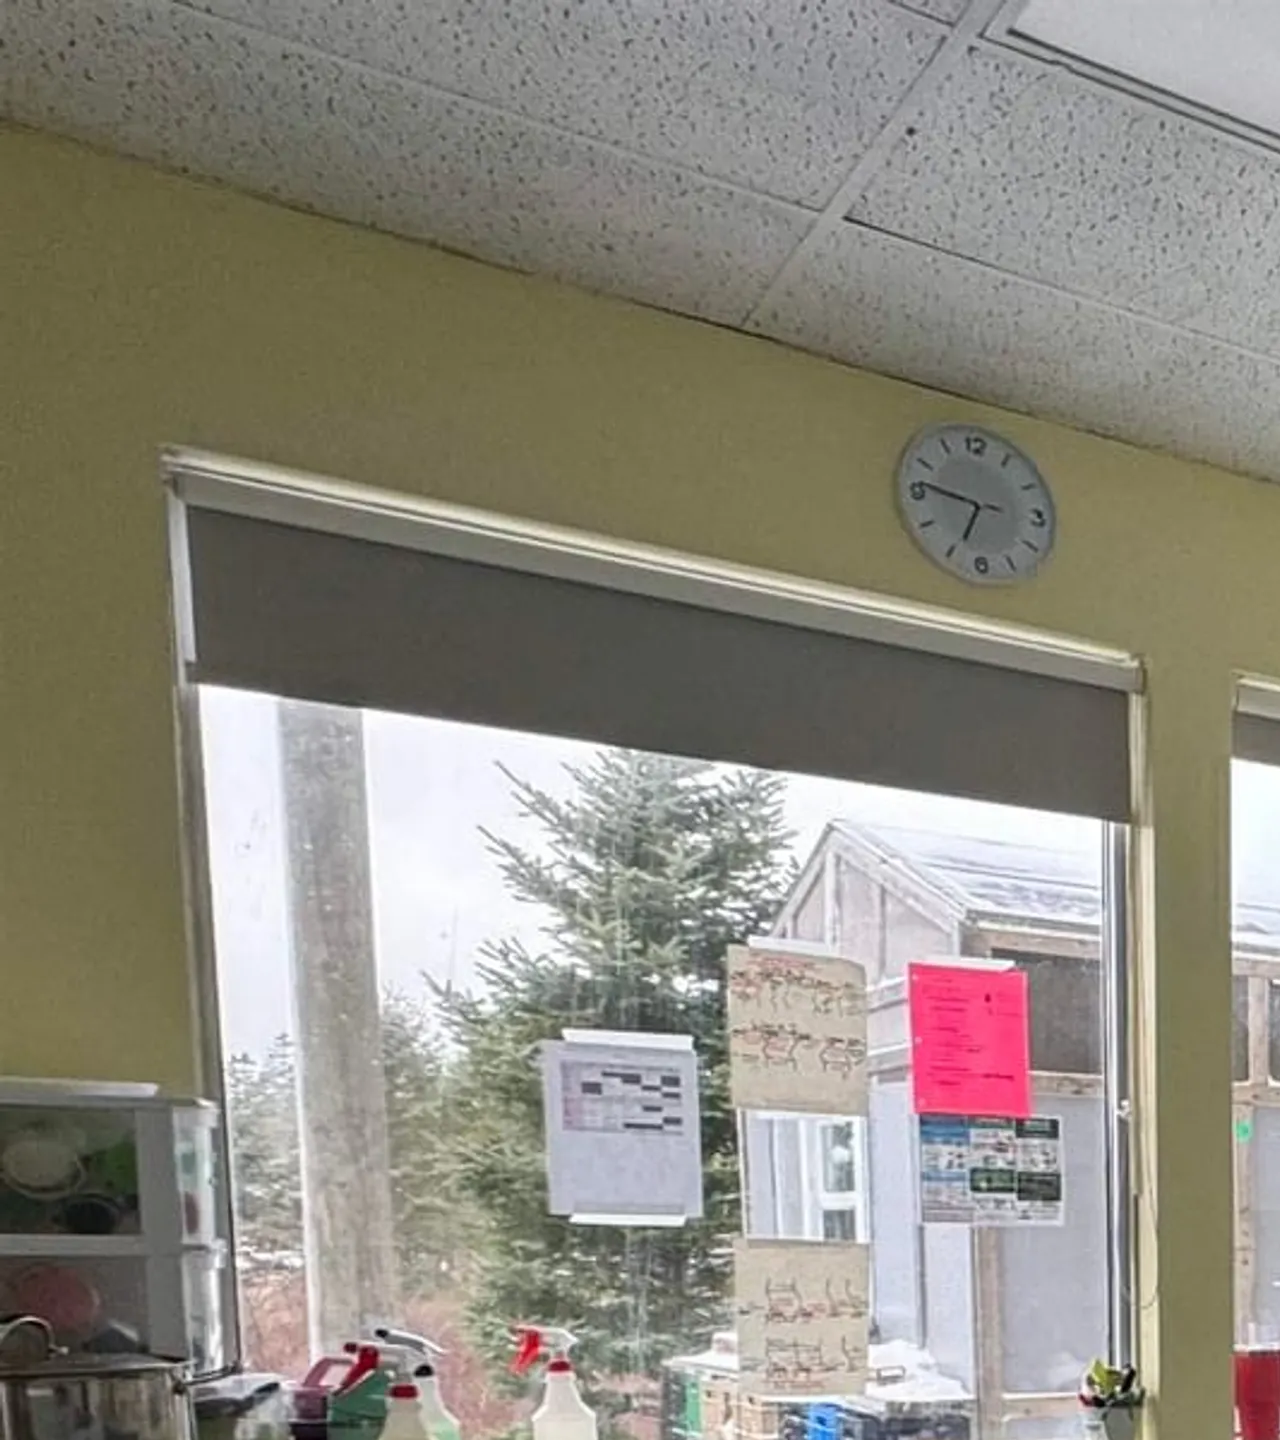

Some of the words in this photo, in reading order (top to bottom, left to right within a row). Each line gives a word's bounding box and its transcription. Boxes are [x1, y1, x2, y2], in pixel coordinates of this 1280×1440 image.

[965, 437, 988, 456] 12
[1030, 508, 1046, 527] 3
[974, 556, 989, 574] 6
